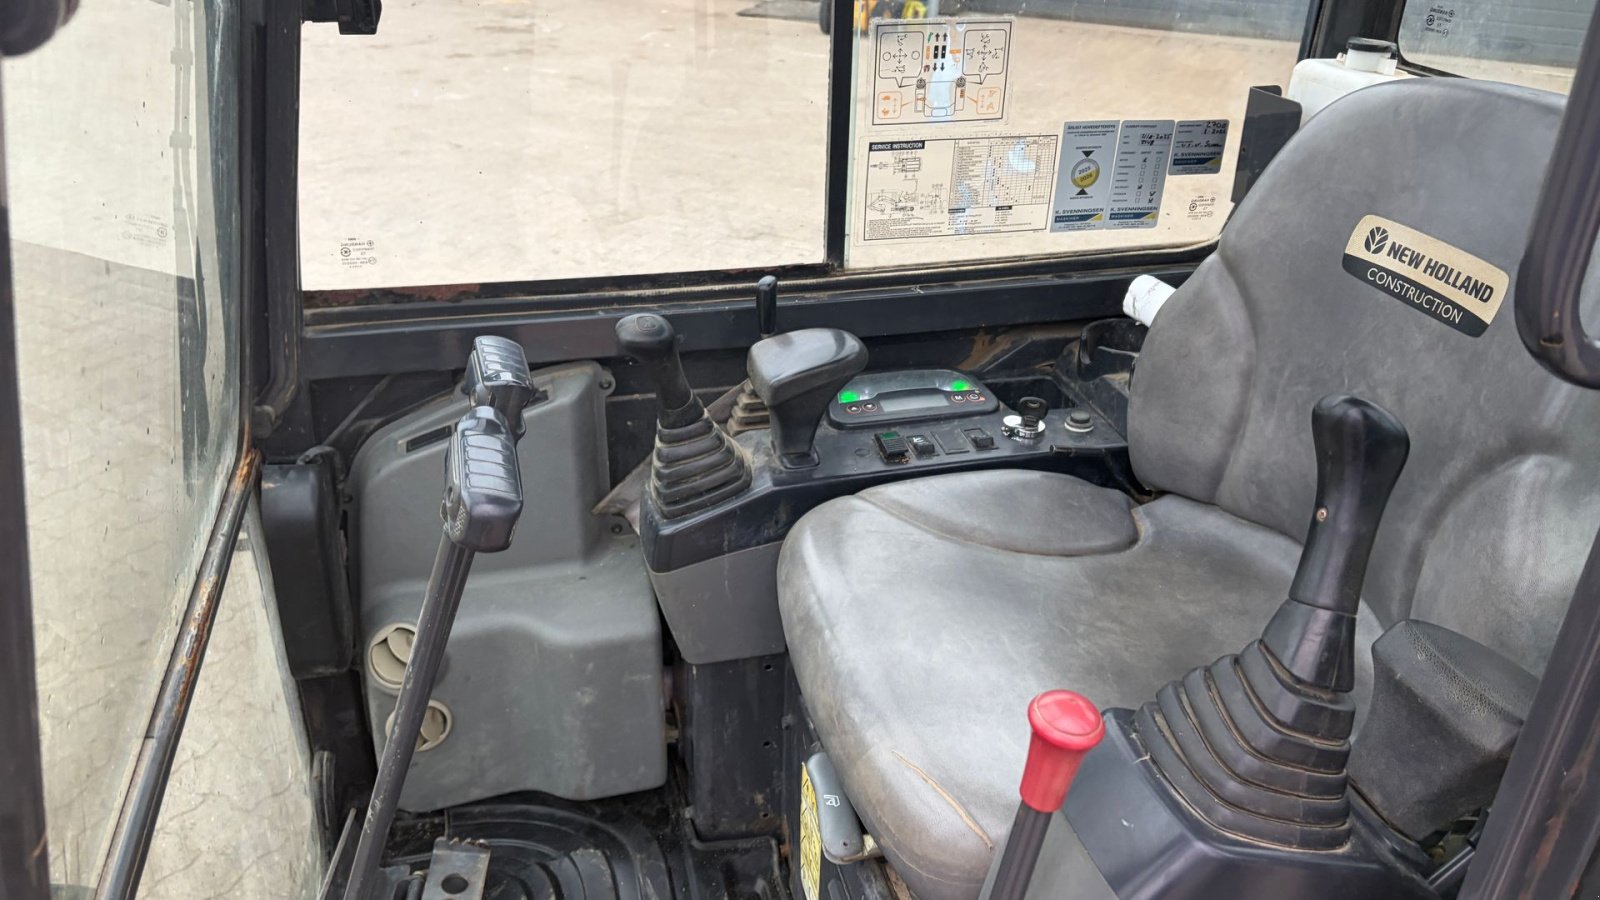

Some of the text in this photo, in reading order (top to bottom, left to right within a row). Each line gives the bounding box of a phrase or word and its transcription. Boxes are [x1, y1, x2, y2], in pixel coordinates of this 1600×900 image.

[871, 142, 923, 151] SERVICE INSTRUCTION
[1367, 267, 1463, 325] CONSTRUCTION
[1386, 241, 1495, 304] NEW HOLLAND
